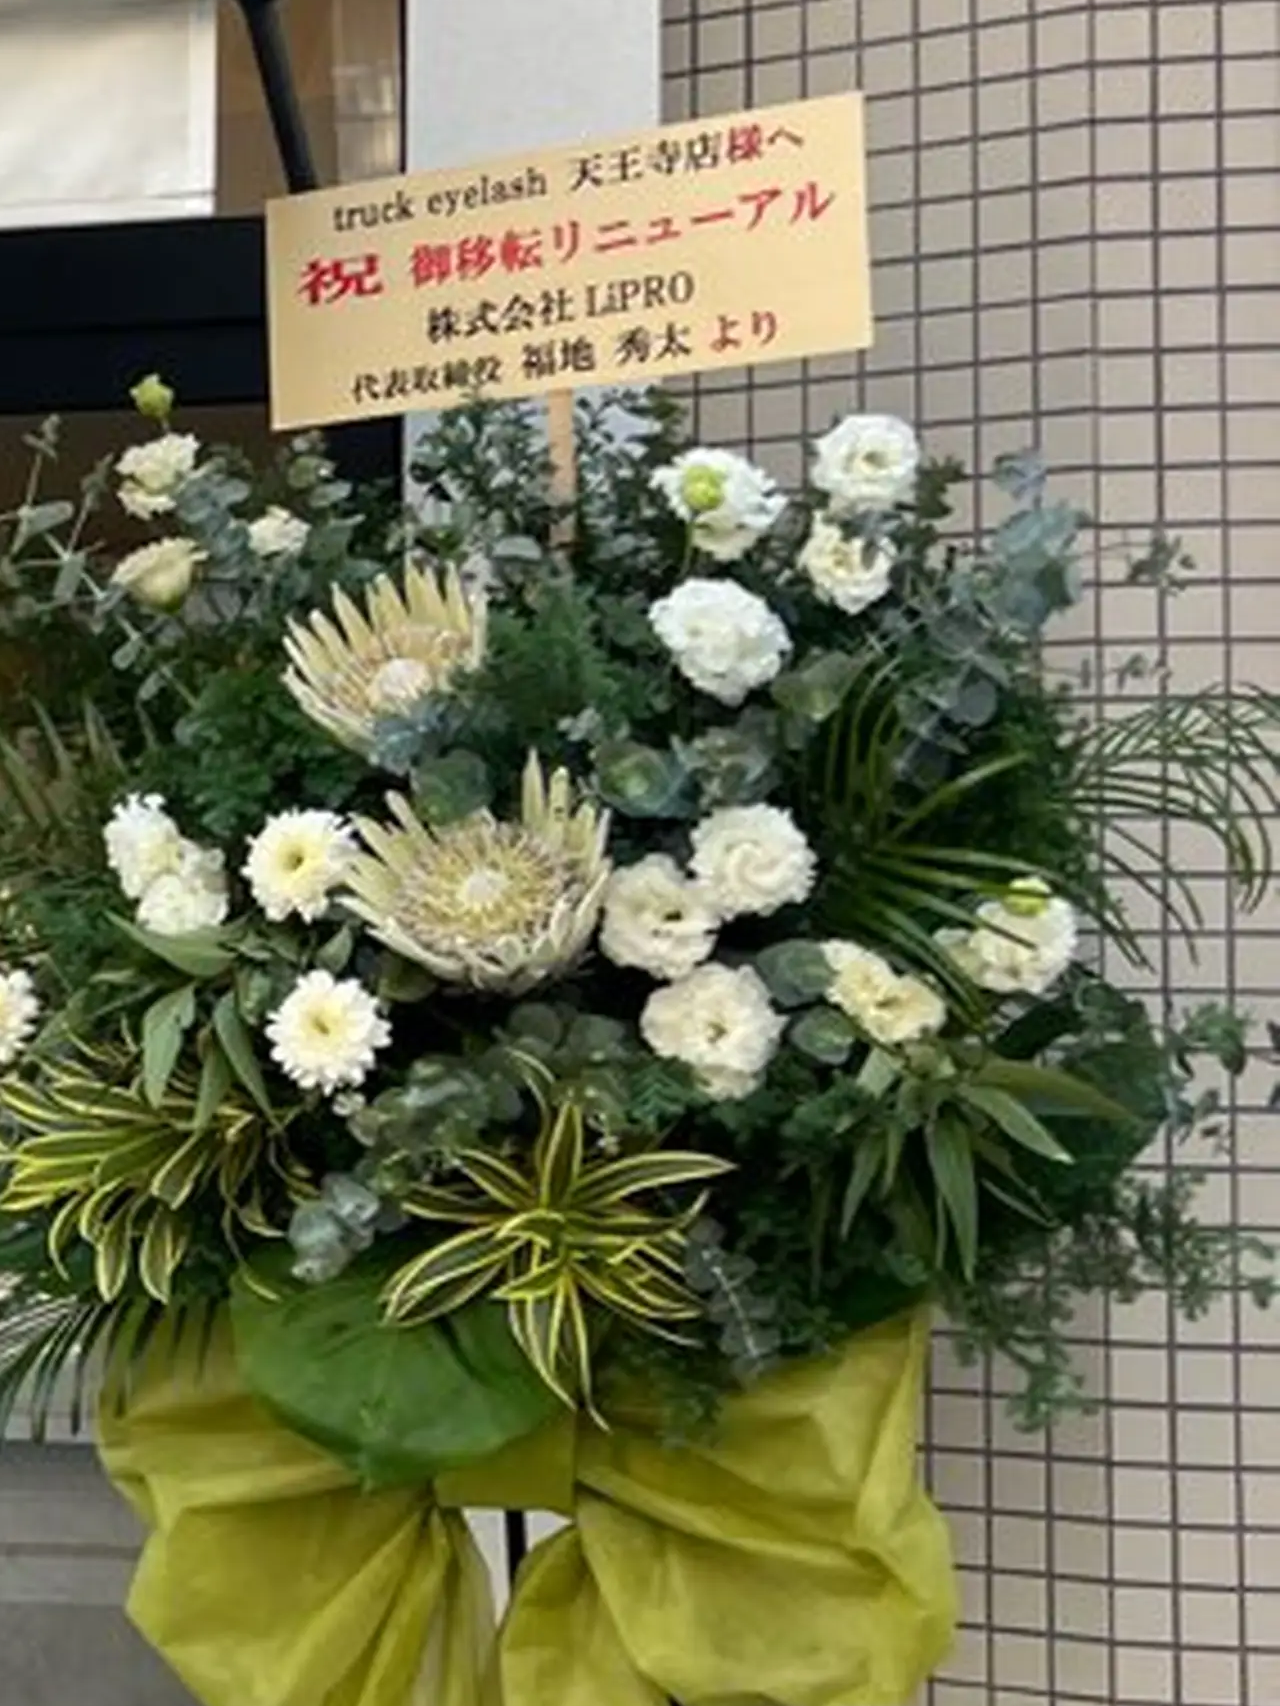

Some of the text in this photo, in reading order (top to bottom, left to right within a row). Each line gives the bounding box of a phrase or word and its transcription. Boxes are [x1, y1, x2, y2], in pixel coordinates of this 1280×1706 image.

[333, 124, 807, 232] truck eyelash 天王寺店様へ
[298, 181, 836, 307] 祝 御移転リニューアル
[352, 309, 780, 406] 代表取締役 福地 秀太 より
[425, 288, 576, 345] 株式会社
